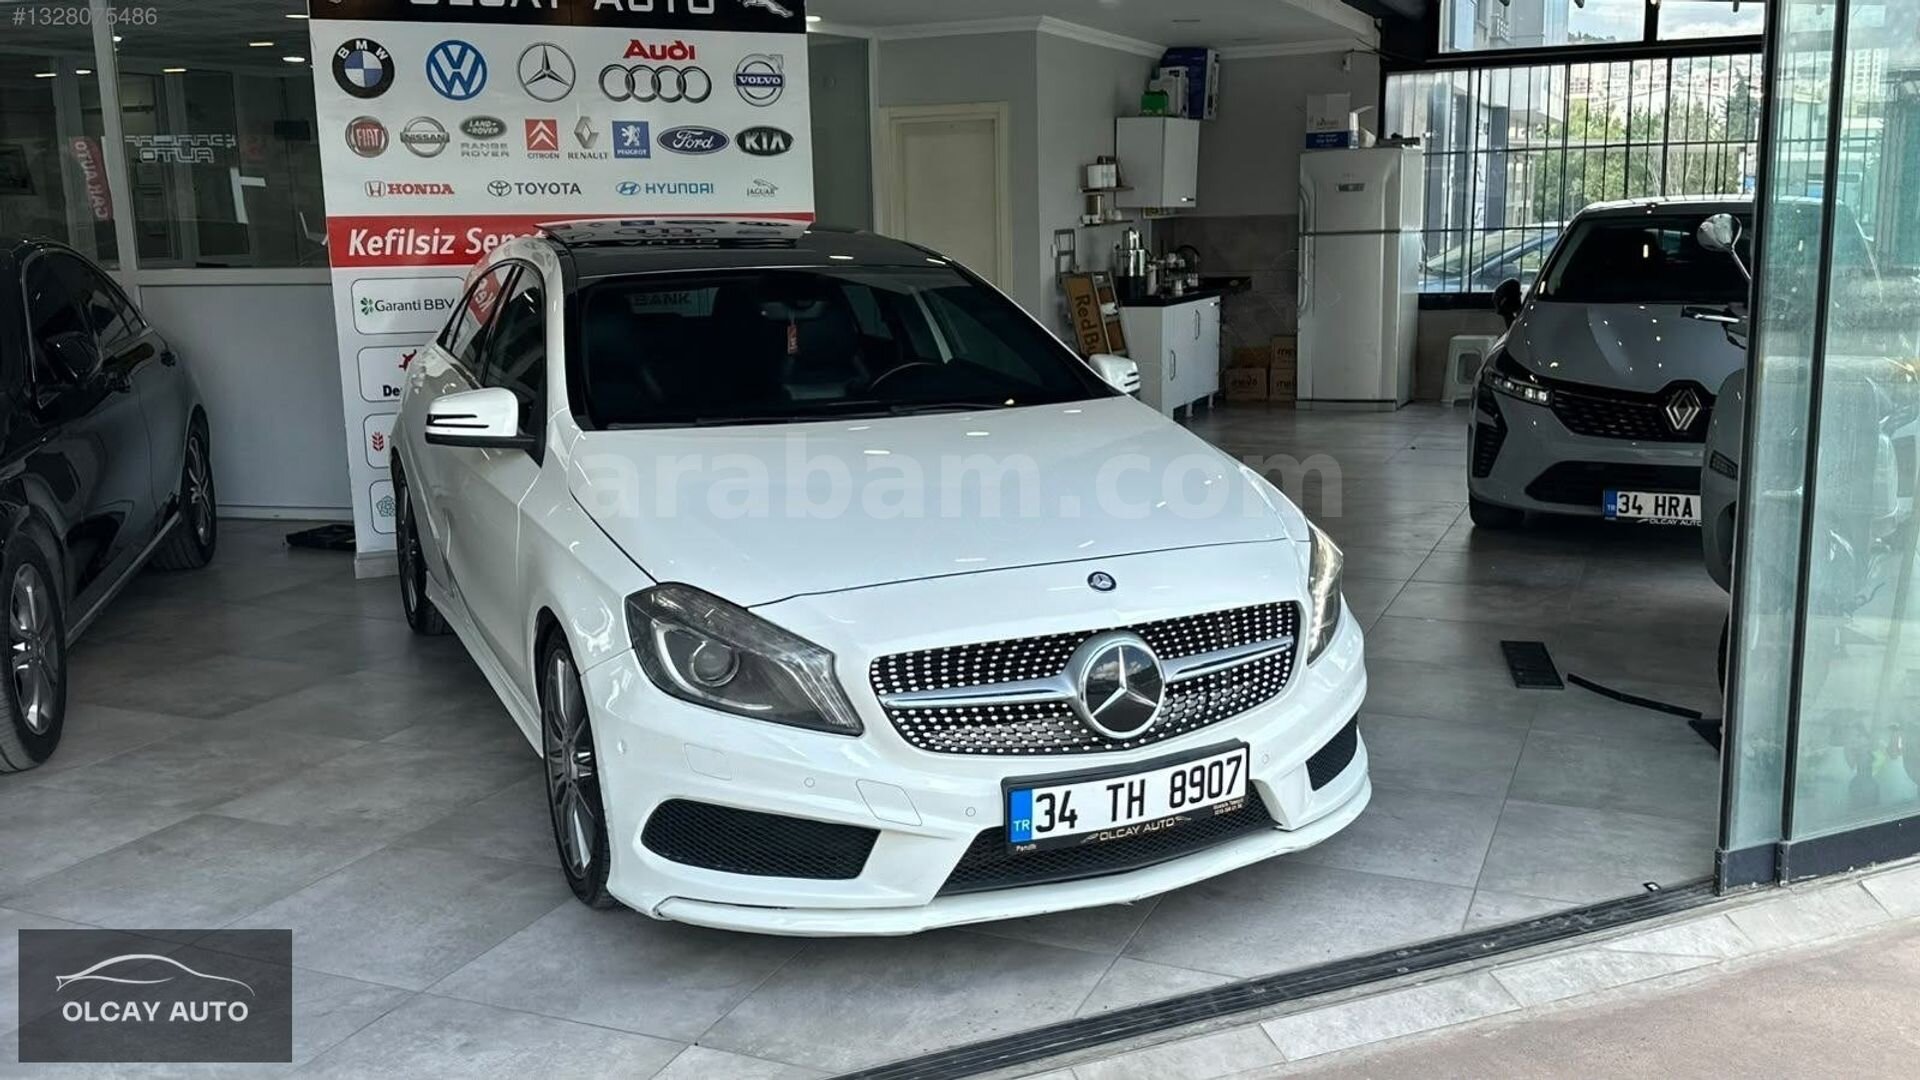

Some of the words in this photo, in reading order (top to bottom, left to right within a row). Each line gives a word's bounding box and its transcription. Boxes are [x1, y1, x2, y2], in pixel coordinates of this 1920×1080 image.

[337, 40, 388, 60] BMW
[623, 39, 695, 60] Audi
[738, 76, 781, 85] VOLVO
[355, 128, 380, 147] FIAT
[403, 133, 447, 142] NISSAN
[672, 130, 714, 149] Ford
[744, 133, 787, 150] KIA
[567, 152, 608, 160] RENAULT
[387, 183, 455, 194] HONDA
[515, 182, 582, 195] TOYOTA
[645, 183, 714, 194] HYUNDAI
[349, 228, 454, 256] Kefilsiz
[374, 300, 421, 312] Garanti
[1618, 494, 1643, 515] 34
[1653, 495, 1693, 518] HRA
[1013, 820, 1031, 832] TR
[1035, 790, 1078, 833] 34
[1106, 779, 1145, 822] TH
[1168, 754, 1242, 809] 8907
[1100, 826, 1140, 842] OLCAY
[1142, 817, 1175, 832] AUTO
